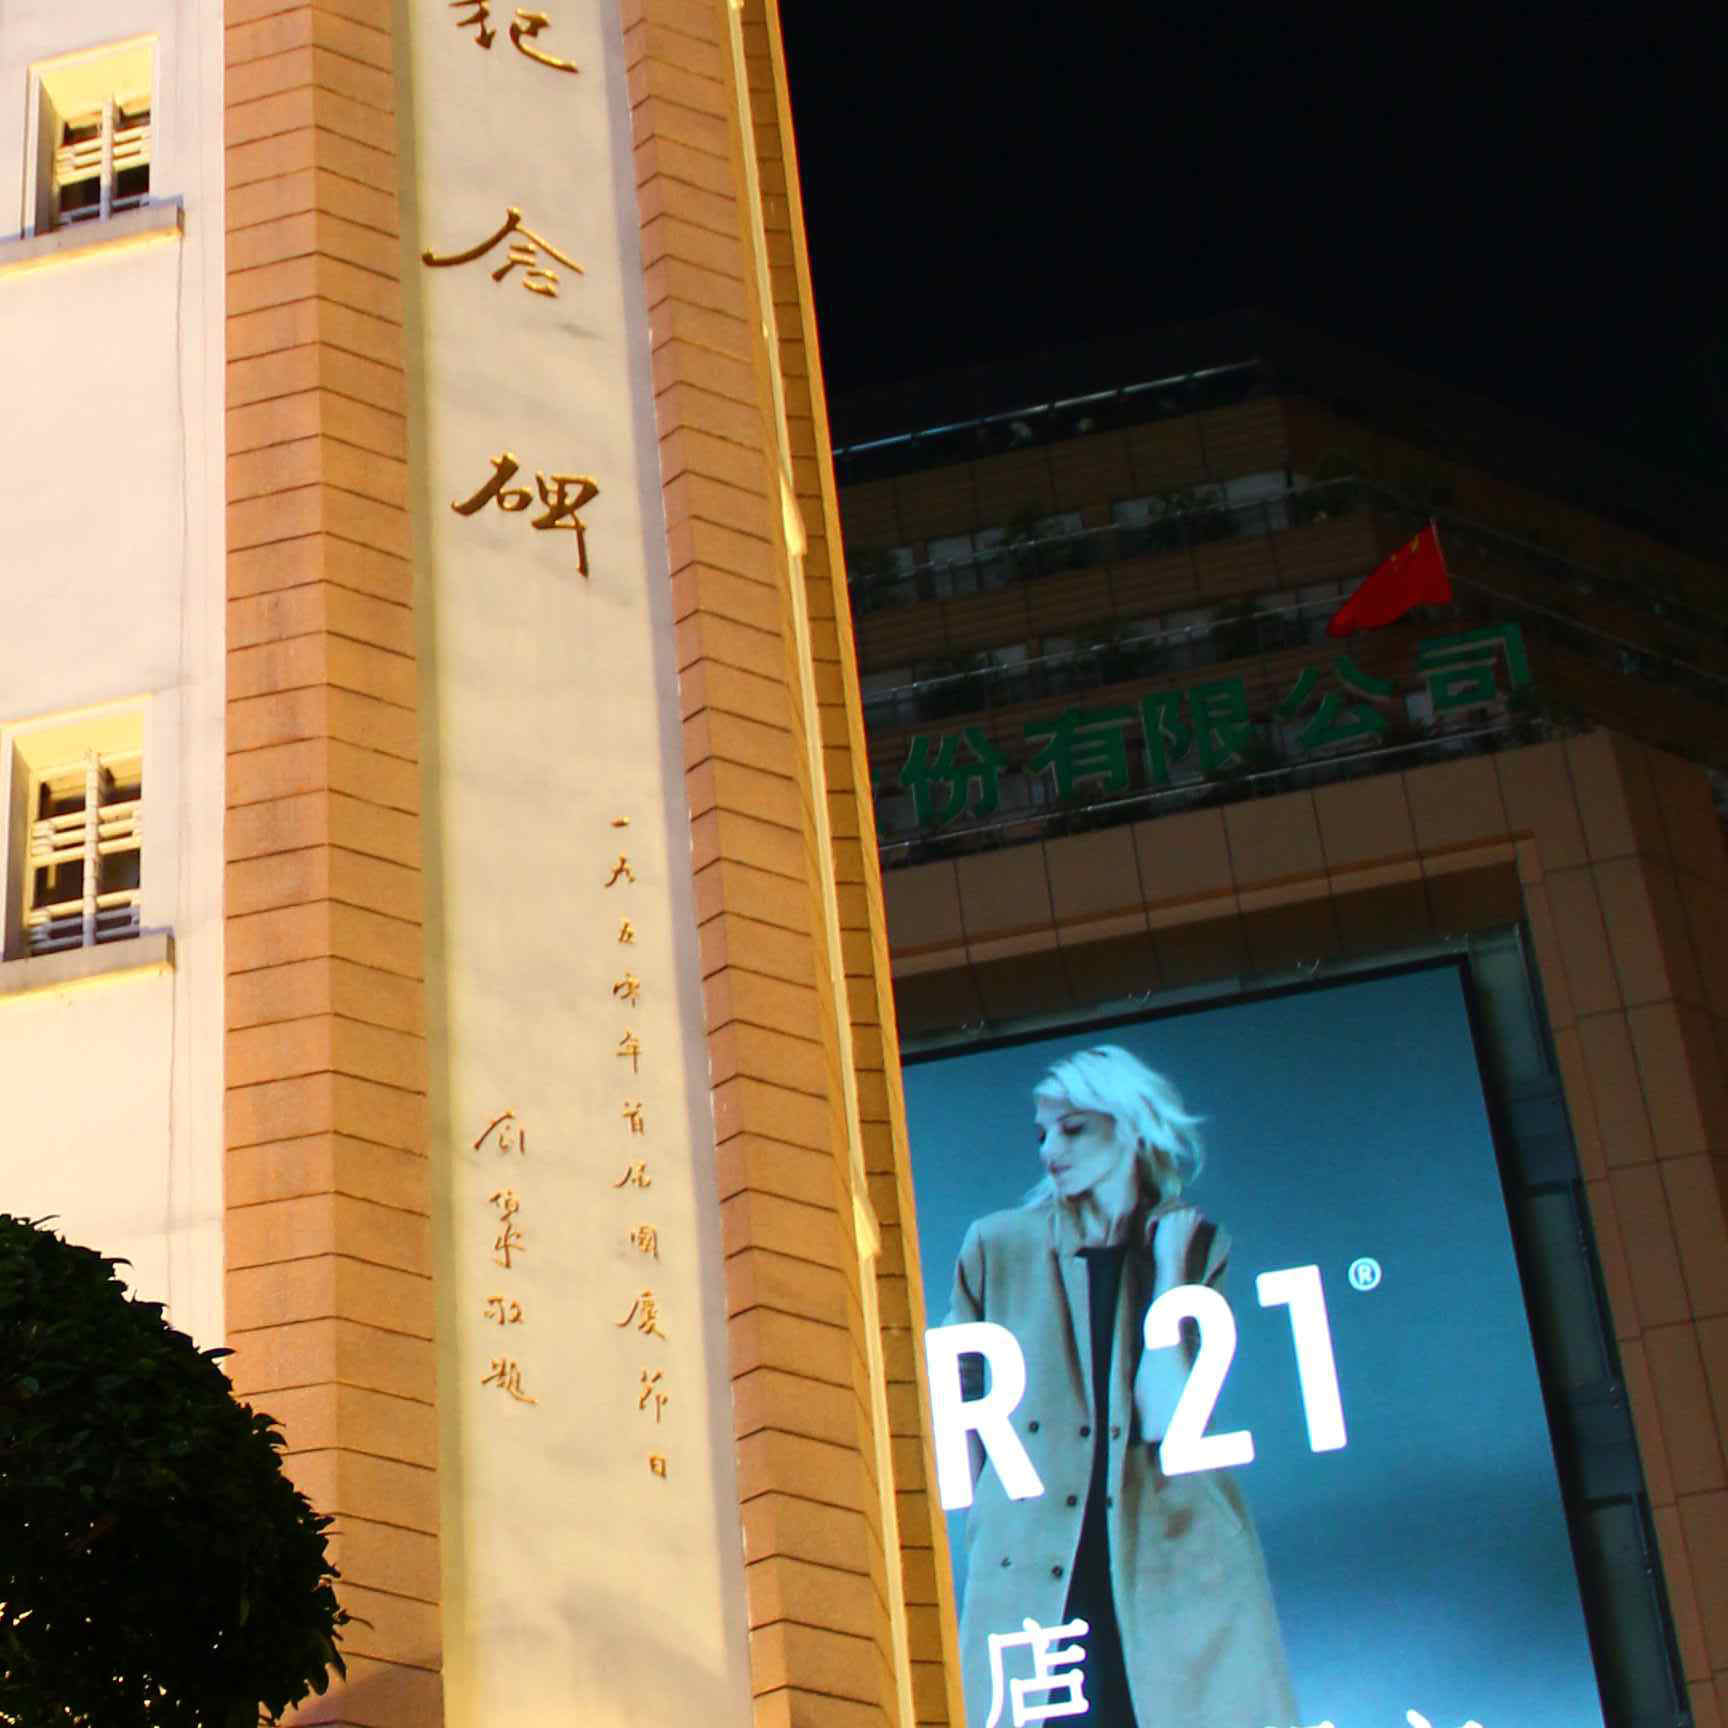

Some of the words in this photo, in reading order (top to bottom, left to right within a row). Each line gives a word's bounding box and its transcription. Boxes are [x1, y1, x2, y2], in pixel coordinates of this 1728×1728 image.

[876, 621, 1532, 833] 份有限公司
